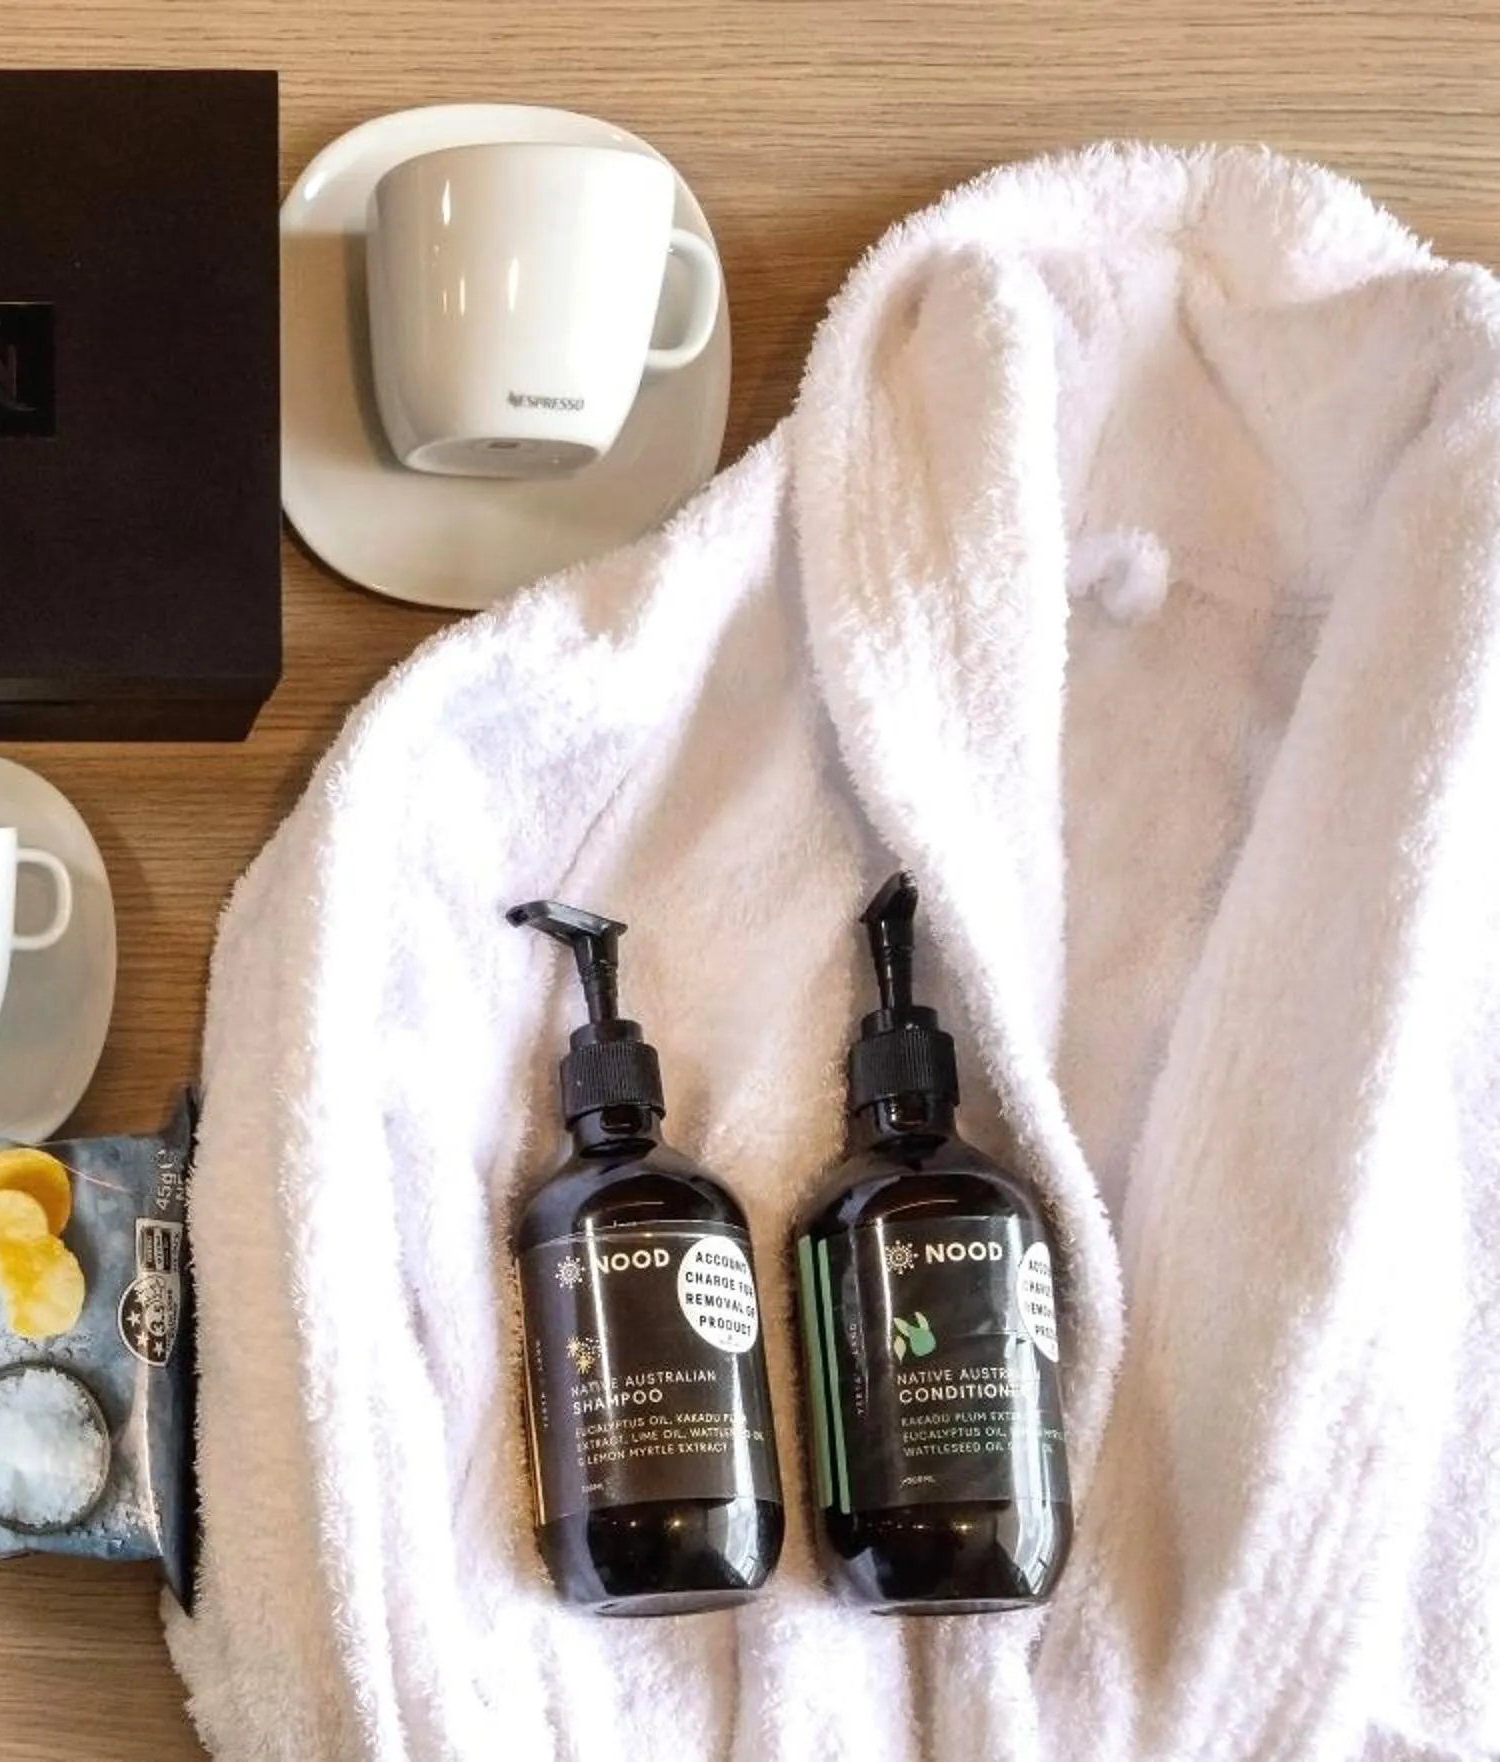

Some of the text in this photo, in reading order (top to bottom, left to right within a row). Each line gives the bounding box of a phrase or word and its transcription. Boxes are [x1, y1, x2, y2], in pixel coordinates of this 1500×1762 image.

[155, 1173, 177, 1211] 45g
[594, 1248, 670, 1275] NOOD
[695, 1252, 746, 1274] ACCOUNT
[925, 1241, 1003, 1264] NOOD
[685, 1271, 735, 1291] CHARGE
[685, 1293, 744, 1314] REMOVAL
[699, 1315, 751, 1336] PRODUCT
[625, 1370, 717, 1387] AUSTRALIAN
[897, 1369, 953, 1385] NATIVE
[573, 1388, 663, 1415] SHAMPOO
[955, 1411, 987, 1421] PLUM
